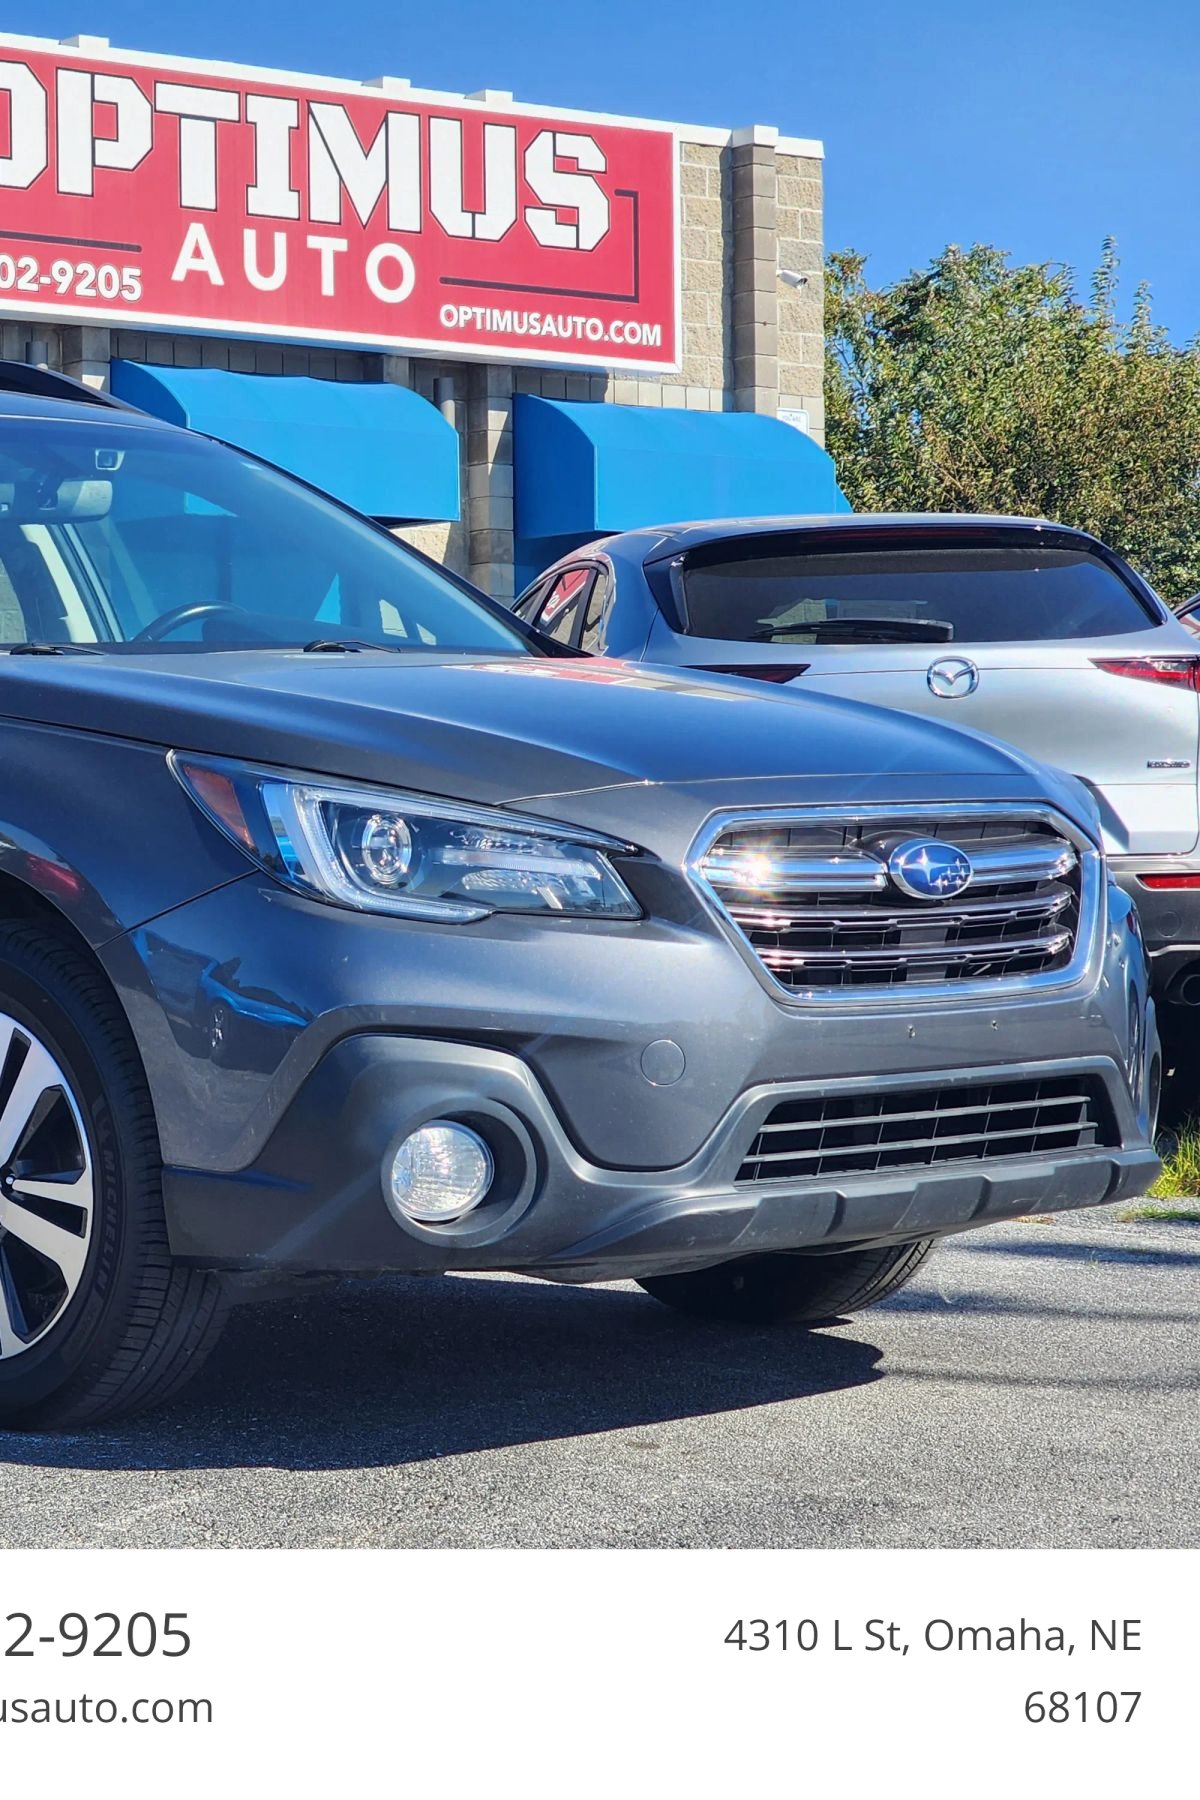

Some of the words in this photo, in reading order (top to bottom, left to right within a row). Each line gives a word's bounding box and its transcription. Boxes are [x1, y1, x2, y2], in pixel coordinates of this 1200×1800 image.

[171, 222, 416, 303] AUTO
[439, 303, 662, 347] OPTIMUSAUTO.COM
[96, 1149, 118, 1292] MICHELIN
